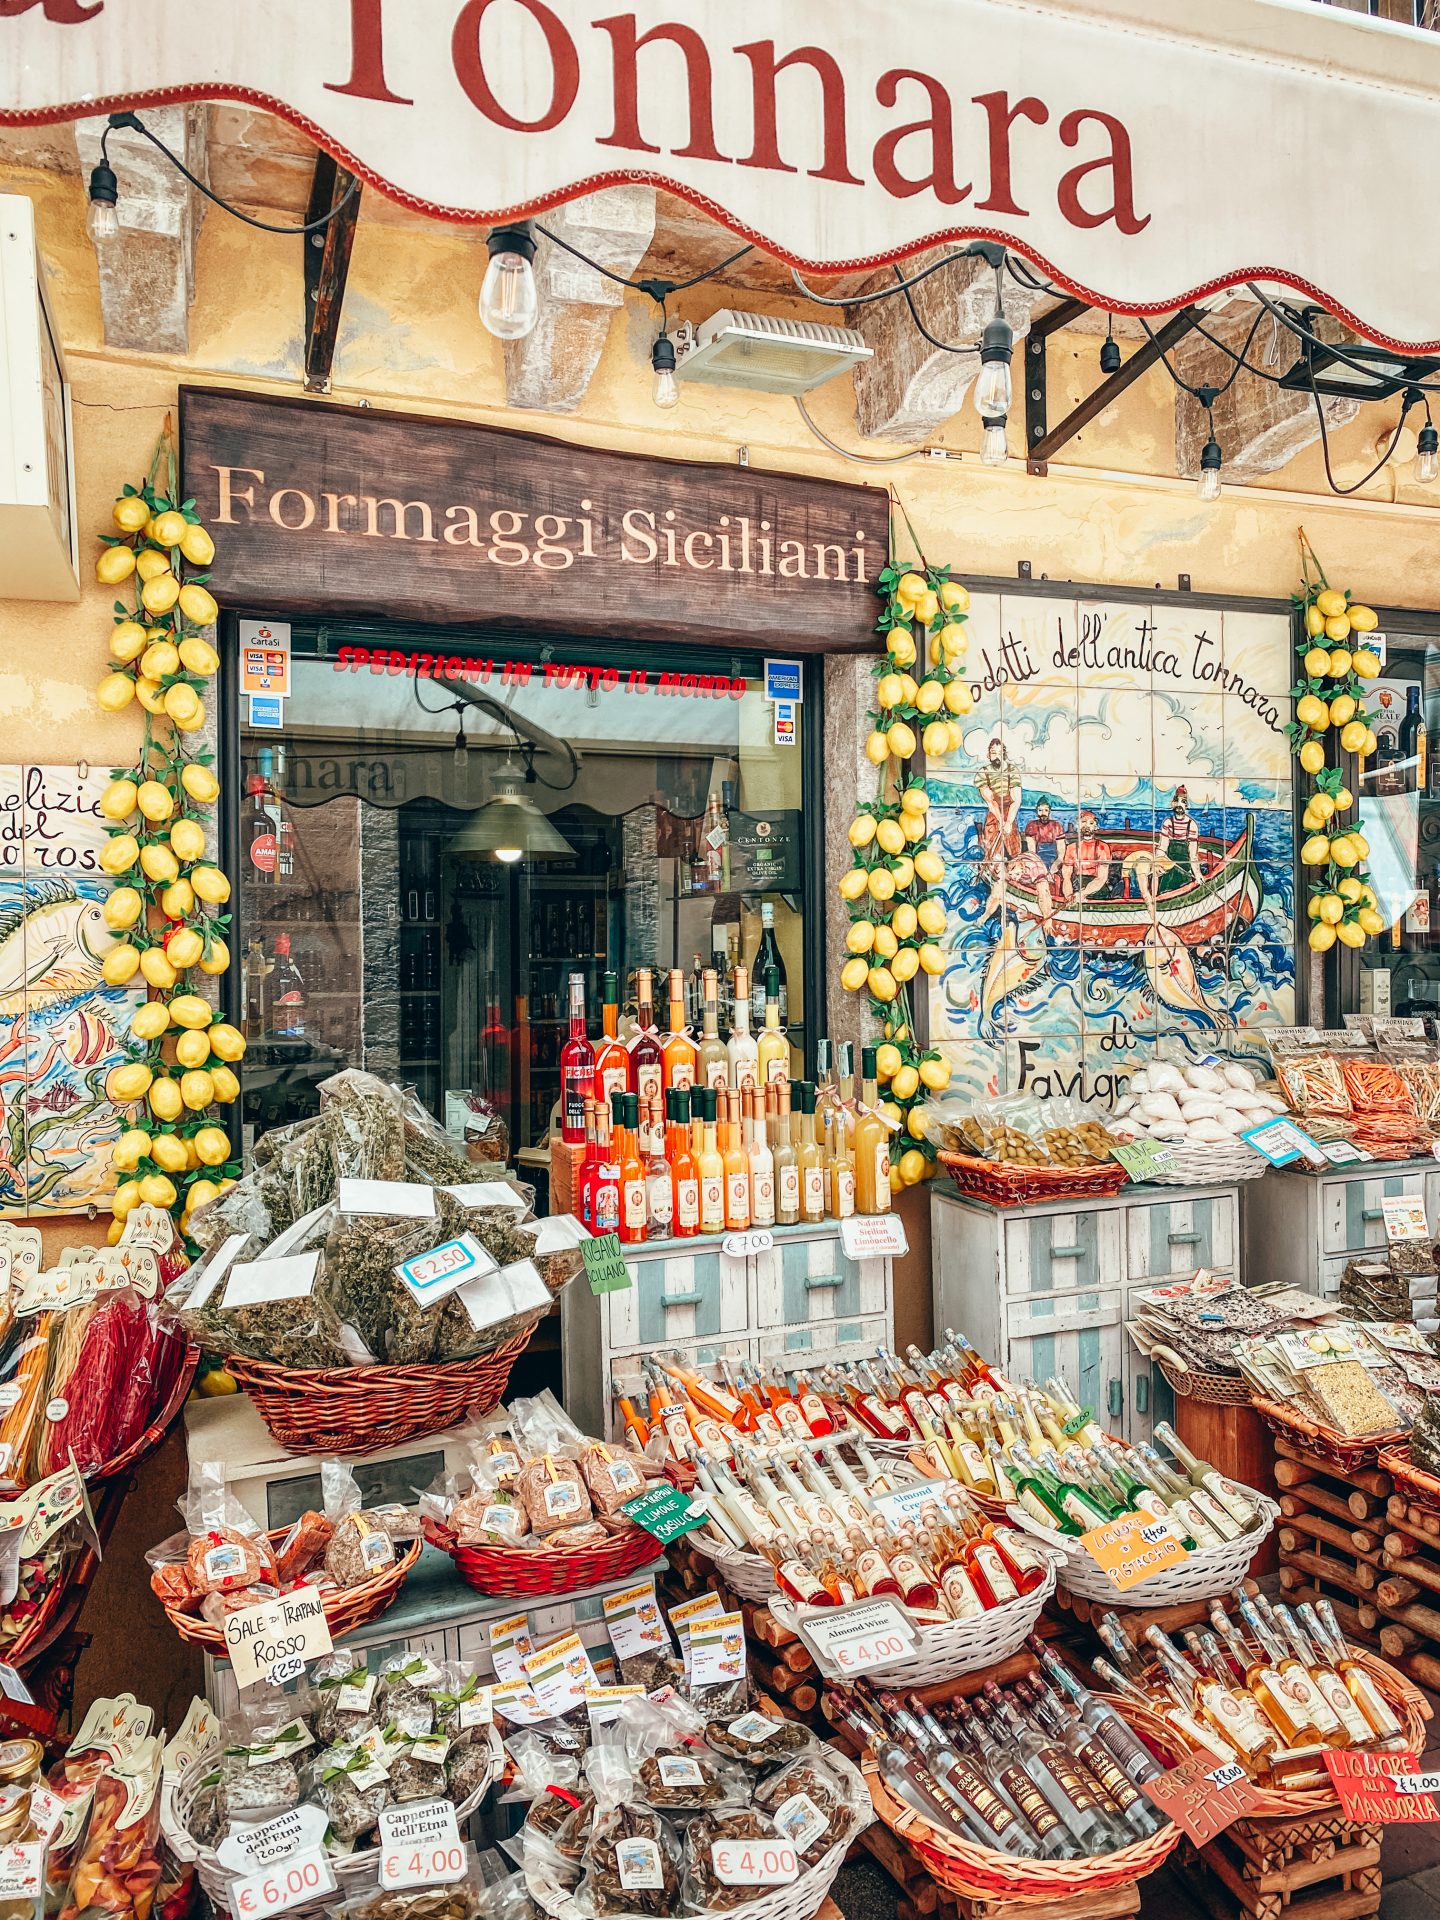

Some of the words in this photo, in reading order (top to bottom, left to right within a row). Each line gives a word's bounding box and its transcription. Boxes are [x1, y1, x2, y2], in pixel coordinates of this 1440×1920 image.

[209, 464, 597, 570] Formaggi
[619, 509, 870, 584] Siciliani
[251, 637, 280, 647] CartaSi
[1053, 613, 1182, 678] dell'antica
[333, 646, 493, 685] SPEDIZIONI
[500, 661, 532, 687] IN
[542, 663, 619, 692] TUTTO
[624, 669, 649, 695] IL
[655, 671, 747, 701] MONDO
[2, 811, 64, 841] del
[33, 846, 105, 871] ros
[1100, 1016, 1137, 1051] di
[854, 1236, 897, 1245] Limoncello
[860, 1228, 888, 1236] Sicilian
[429, 1249, 467, 1277] 2,50
[892, 1486, 933, 1504] Almond
[644, 1499, 679, 1521] LIMONE
[1093, 1517, 1146, 1550] LIQUORE
[1108, 1540, 1177, 1583] PISTACCHIO
[623, 1586, 653, 1603] Tricolore
[689, 1597, 719, 1612] Tricolore
[228, 1616, 266, 1645] SALE
[268, 1615, 280, 1624] DI
[277, 1600, 323, 1627] TRAPANI
[691, 1623, 709, 1632] Pepe
[710, 1616, 741, 1627] Tricolore
[805, 1618, 828, 1628] Vino
[828, 1614, 846, 1623] alla
[846, 1602, 891, 1617] Mandorla
[828, 1624, 865, 1639] Almond
[865, 1618, 889, 1629] Wine
[253, 1634, 306, 1668] ROSSO
[527, 1657, 547, 1670] Pepe
[548, 1638, 580, 1660] Tricolore
[838, 1649, 854, 1666] €
[858, 1637, 903, 1661] 4,00
[586, 1689, 607, 1698] Pepe
[608, 1687, 644, 1695] Tricolore
[1151, 1756, 1214, 1800] GRAPPA
[1331, 1753, 1414, 1778] LIQUORE
[1363, 1779, 1387, 1792] ALLA
[386, 1802, 449, 1824] Capperini
[1184, 1783, 1256, 1839] ETNA
[1344, 1795, 1440, 1821] MANDORLA
[237, 1811, 300, 1844] Capperini
[246, 1825, 302, 1854] dell'Etna
[391, 1819, 448, 1838] dell'Etna
[384, 1855, 400, 1878] €
[408, 1848, 462, 1878] 4,00
[716, 1851, 733, 1875] €
[740, 1849, 795, 1879] 4,00
[238, 1888, 257, 1912] €
[263, 1862, 319, 1904] 6,00
